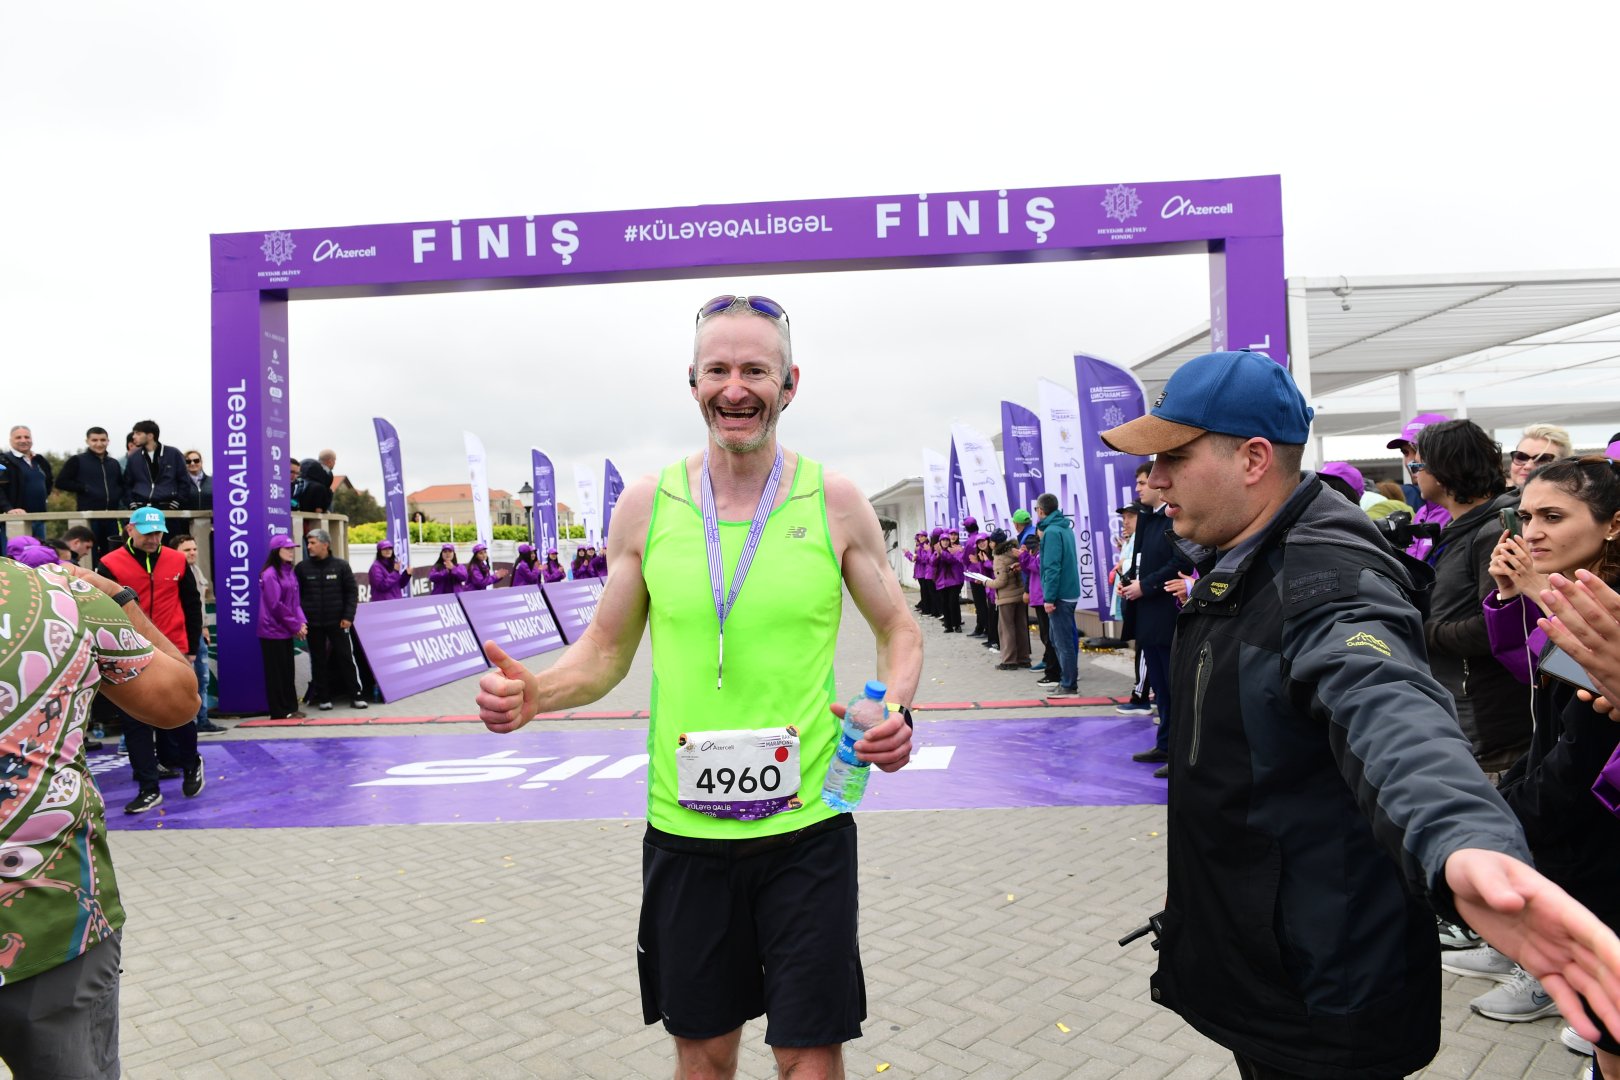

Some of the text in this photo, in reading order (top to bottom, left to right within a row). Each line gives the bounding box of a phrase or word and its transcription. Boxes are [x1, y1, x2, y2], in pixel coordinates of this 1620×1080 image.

[875, 192, 1056, 244] FİNİŞ
[1186, 203, 1234, 216] Azercell
[412, 214, 580, 266] FİNİŞ
[623, 212, 834, 244] #KÜLƏYƏQALİBGƏL
[335, 246, 377, 259] Azercell
[224, 378, 251, 625] #KÜLƏYƏQALİBGƏL
[145, 513, 160, 522] AZE
[437, 602, 465, 627] BAKI
[523, 592, 546, 612] BAKI
[506, 615, 556, 643] MARAFONU
[411, 630, 477, 666] MARAFONU
[696, 764, 781, 794] 4960
